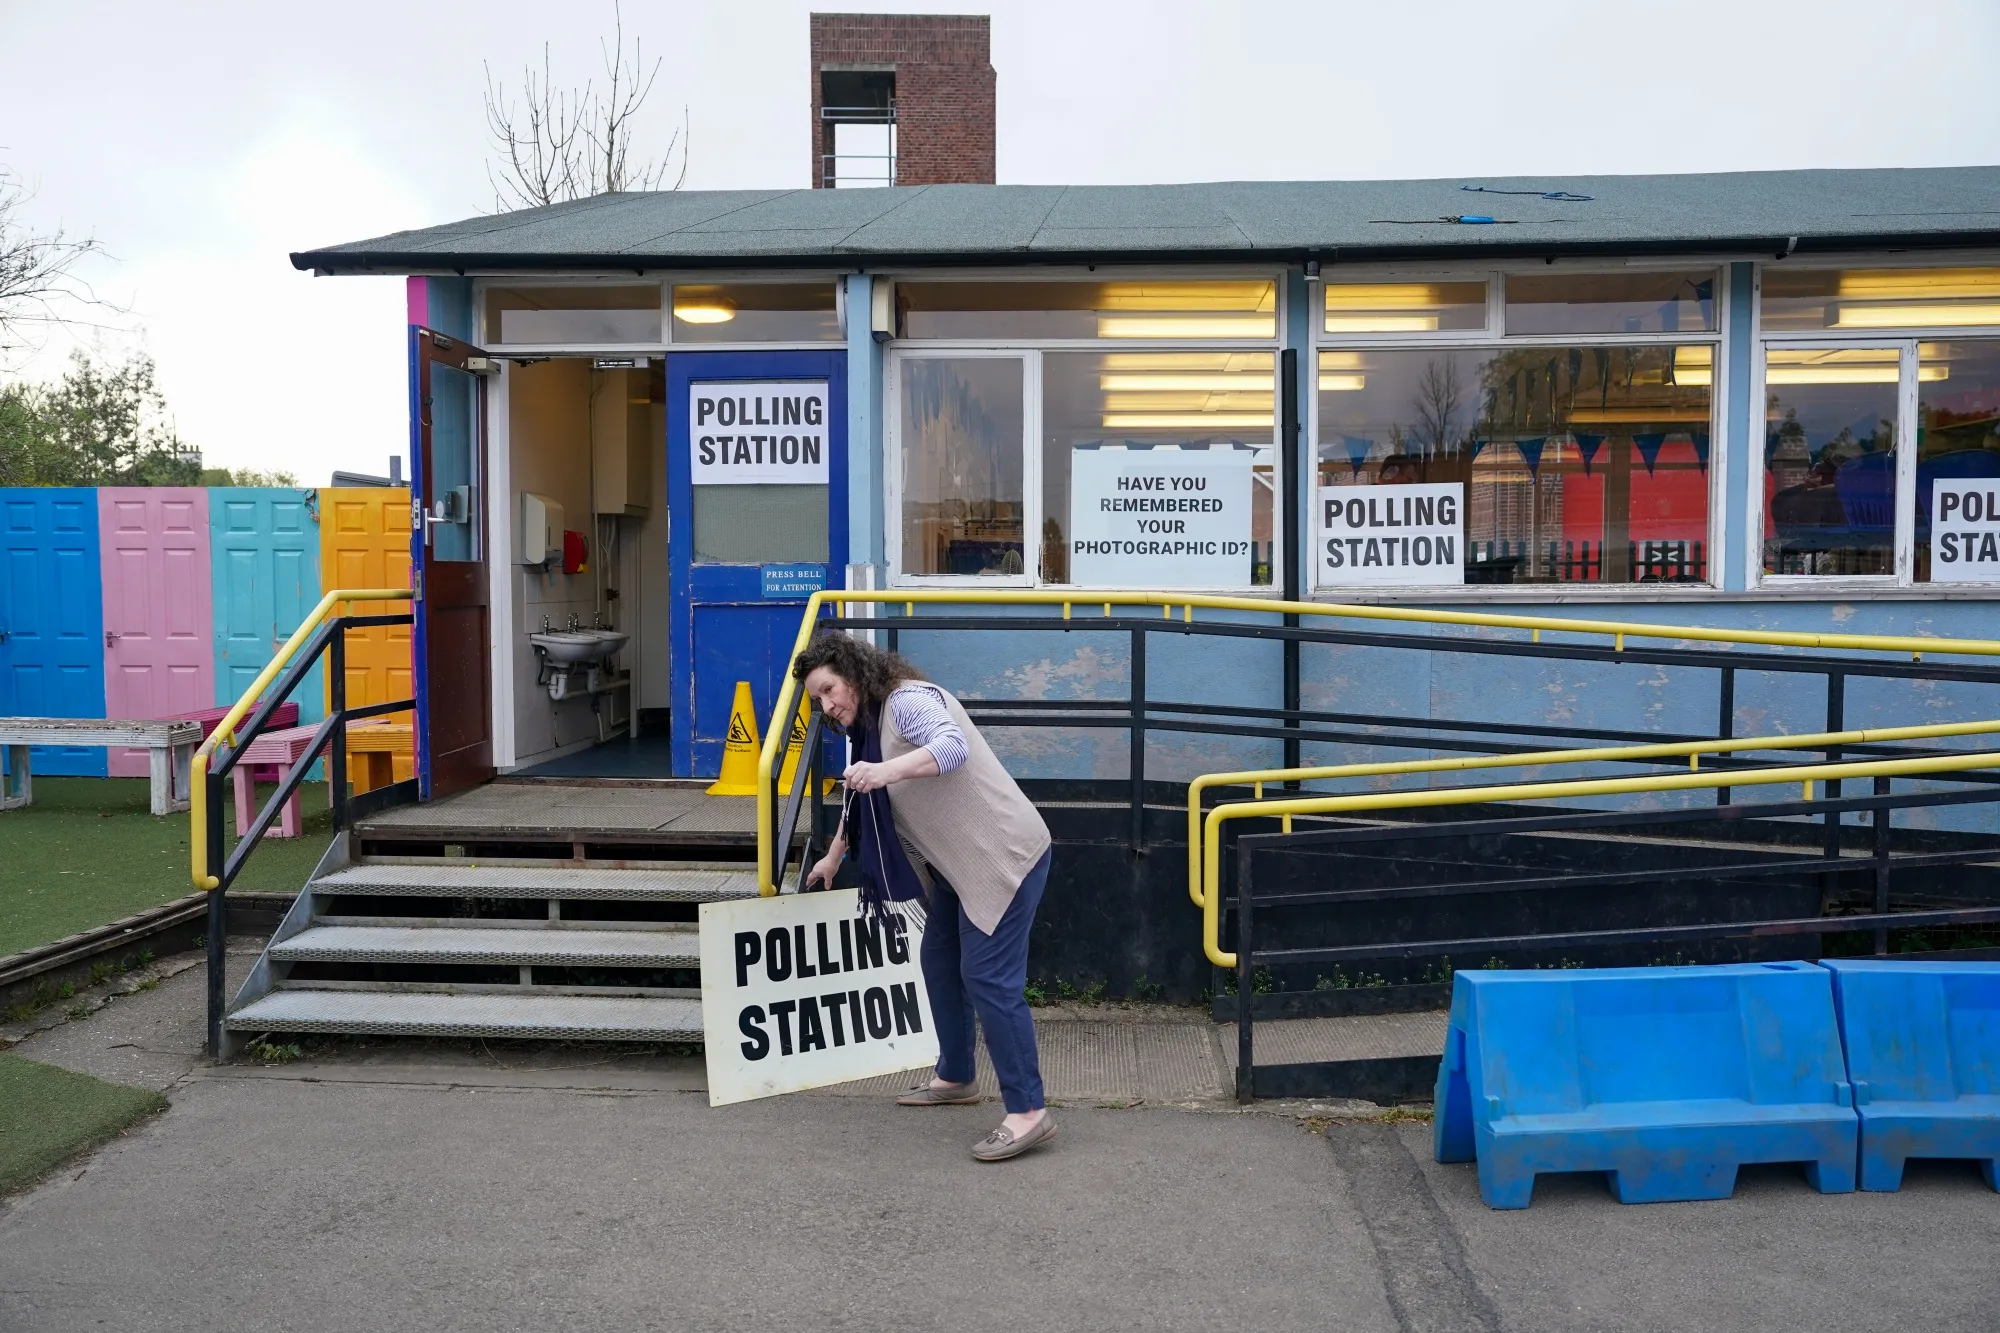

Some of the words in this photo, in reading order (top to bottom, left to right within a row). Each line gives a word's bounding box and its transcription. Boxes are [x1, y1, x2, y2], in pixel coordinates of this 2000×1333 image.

[697, 396, 823, 427] POLLING
[698, 435, 821, 466] STATION
[1117, 477, 1166, 491] HAVE
[1170, 477, 1207, 491] YOU
[1100, 498, 1223, 513] REMEMBERED
[1324, 495, 1456, 529] POLLING
[1940, 491, 2000, 522] POL
[1136, 519, 1186, 534] YOUR
[1074, 540, 1217, 555] PHOTOGRAPHIC
[1221, 541, 1249, 556] ID?
[1326, 536, 1455, 568] STATION
[1939, 532, 2000, 563] STA
[766, 570, 794, 579] PRESS
[797, 570, 822, 578] BELL
[766, 584, 780, 592] FOR
[782, 583, 822, 592] ATTENTION
[734, 913, 911, 988] POLLING
[738, 981, 924, 1062] STATION
